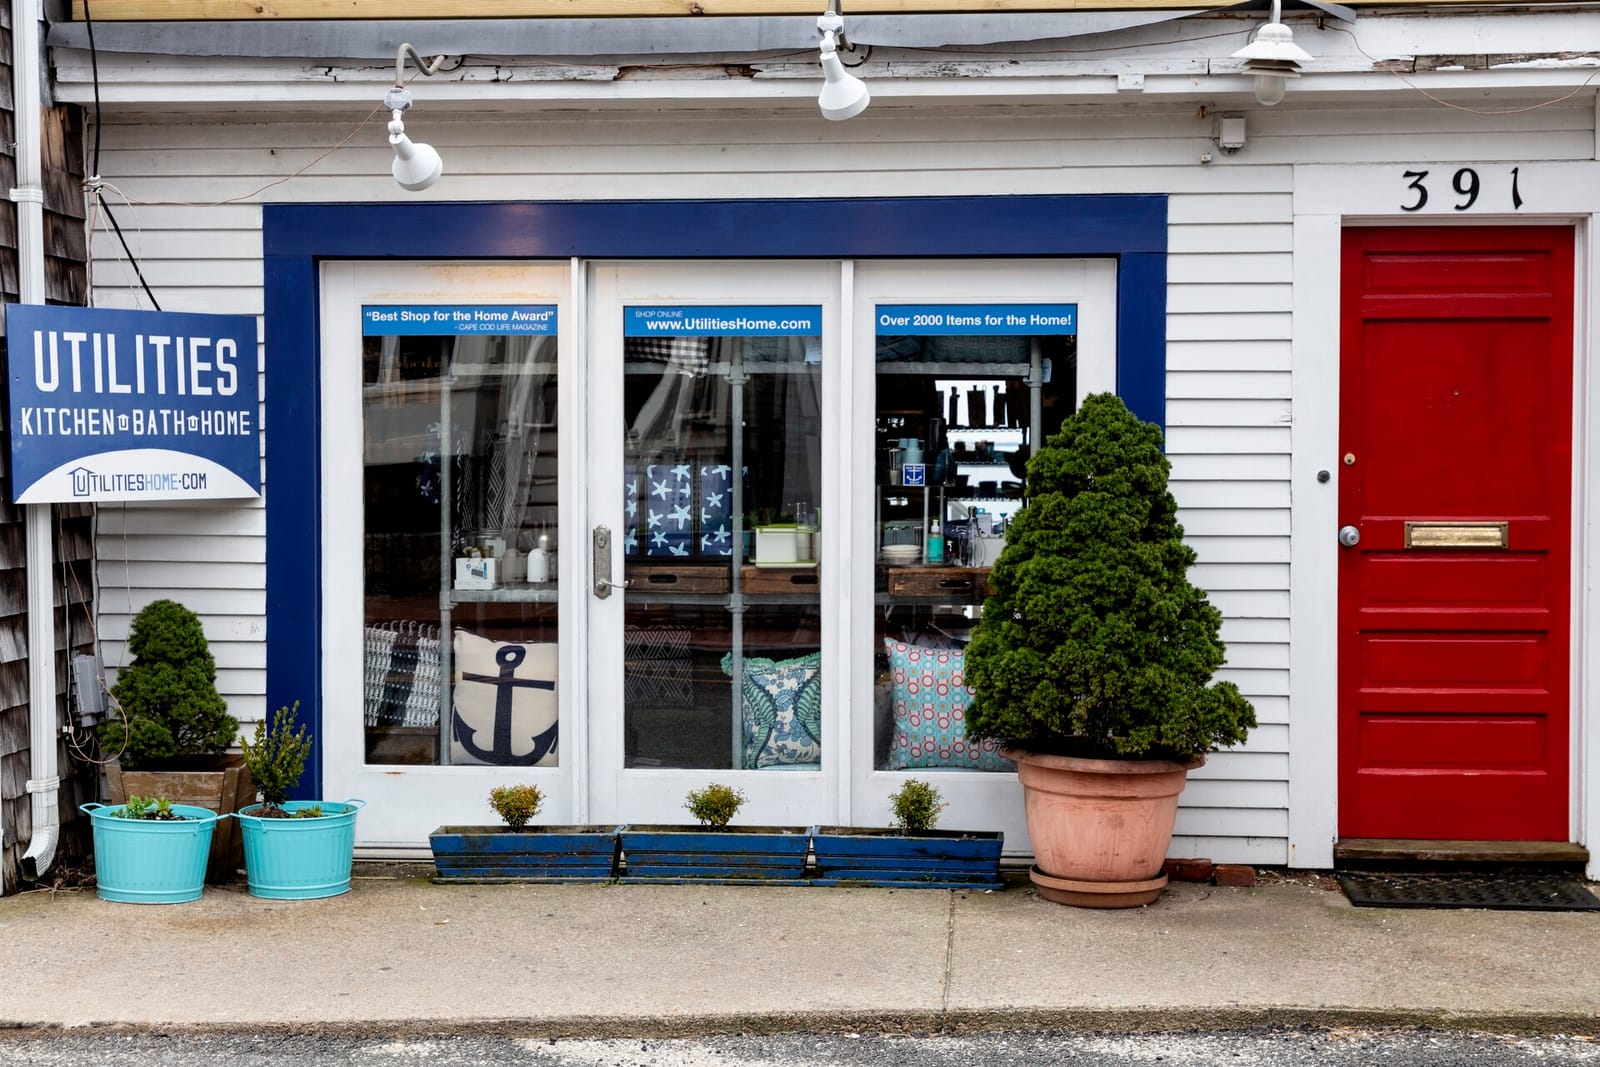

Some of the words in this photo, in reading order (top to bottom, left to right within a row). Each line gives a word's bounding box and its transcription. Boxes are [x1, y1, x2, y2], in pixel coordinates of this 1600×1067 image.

[1400, 167, 1523, 212] 391
[366, 311, 398, 321] “Best
[400, 311, 431, 323] Shop
[433, 311, 450, 321] for
[452, 311, 471, 321] the
[474, 311, 508, 321] Home
[511, 311, 554, 321] Award”
[635, 310, 656, 318] SHOP
[656, 310, 684, 318] ONLINE
[879, 314, 909, 326] Over
[913, 314, 943, 326] 2000
[946, 314, 982, 326] Items
[984, 314, 1002, 326] for
[1006, 314, 1027, 326] the
[1030, 314, 1072, 326] Home!
[458, 323, 478, 331] CAPE
[479, 323, 495, 331] COD
[496, 323, 511, 331] LIFE
[511, 323, 548, 331] MAGAZINE
[646, 318, 811, 330] www.UtilitiesHome.com
[33, 330, 238, 396] UTILITIES
[21, 407, 115, 435] KITCHEN
[132, 408, 186, 435] BATH
[201, 410, 250, 436] HOME
